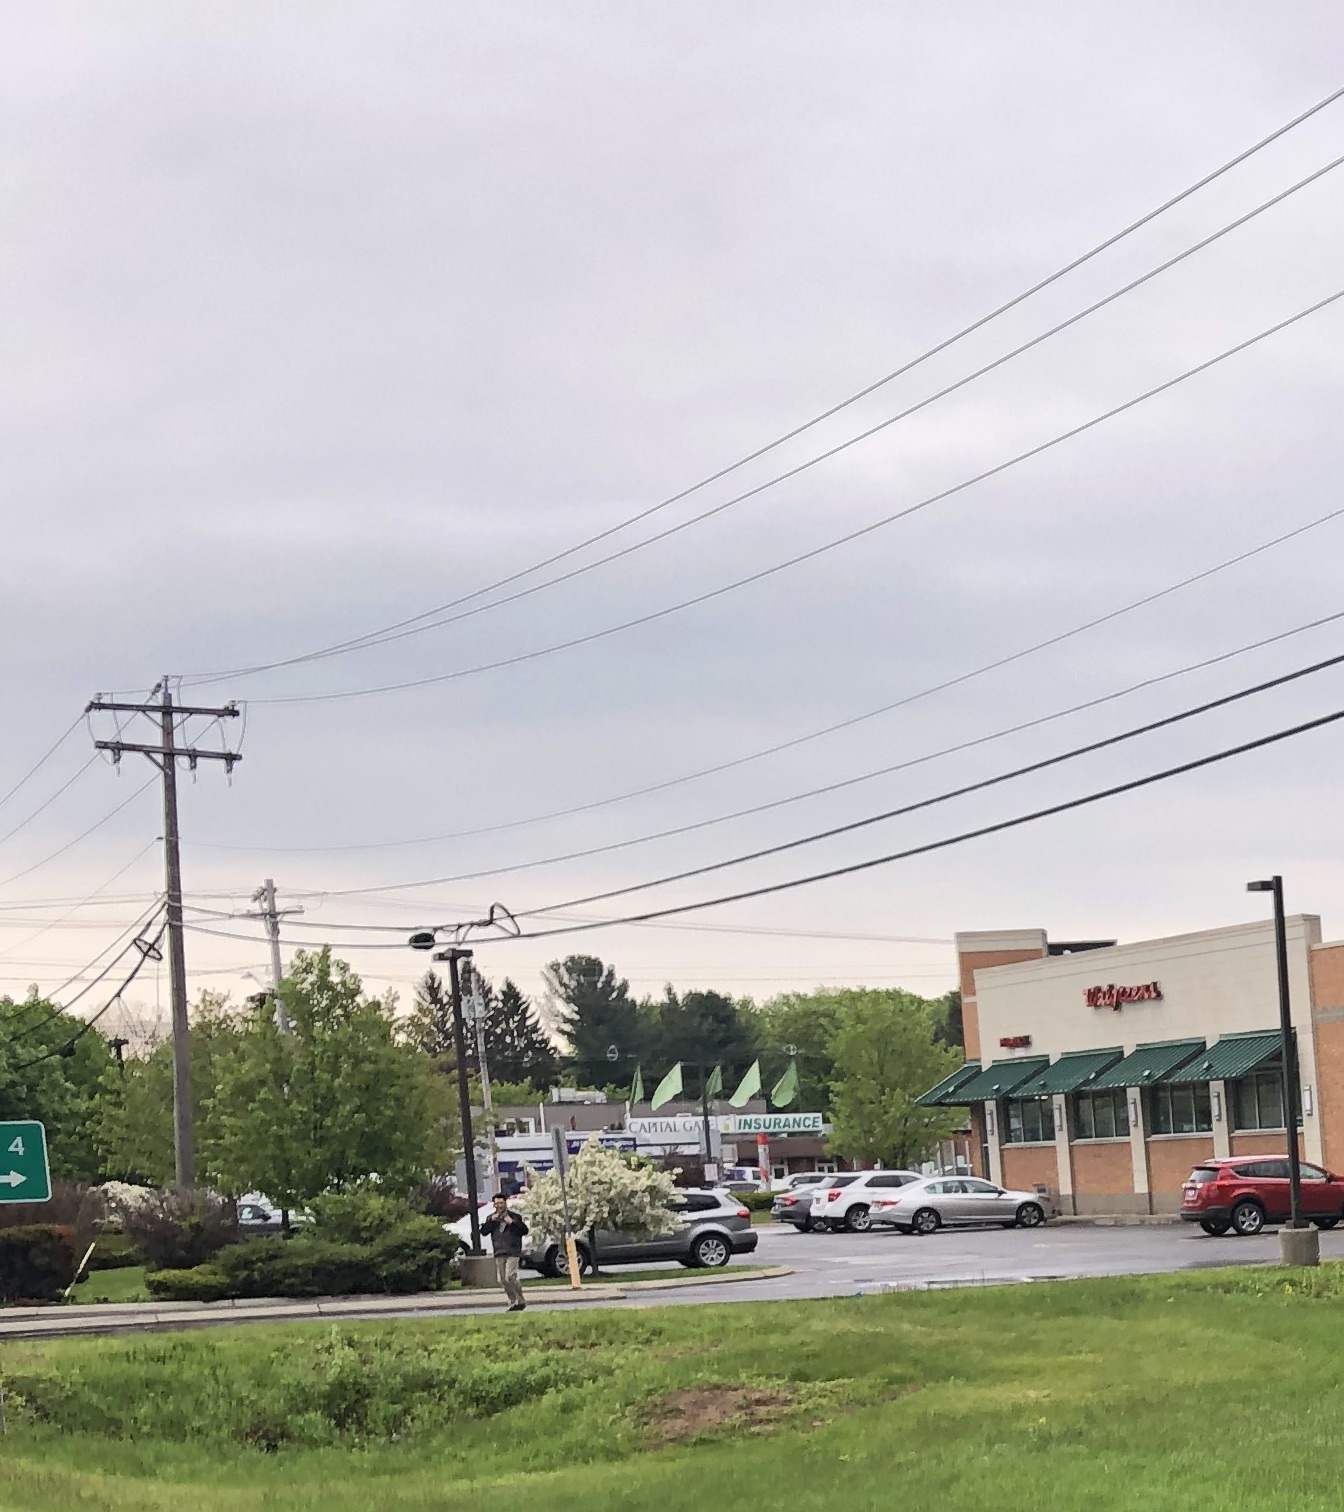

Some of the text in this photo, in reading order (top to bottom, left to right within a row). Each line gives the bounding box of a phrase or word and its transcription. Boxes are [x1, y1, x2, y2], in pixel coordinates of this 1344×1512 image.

[628, 1120, 680, 1134] CAPITAL
[737, 1116, 821, 1131] INSURANCE
[7, 1136, 25, 1156] 4
